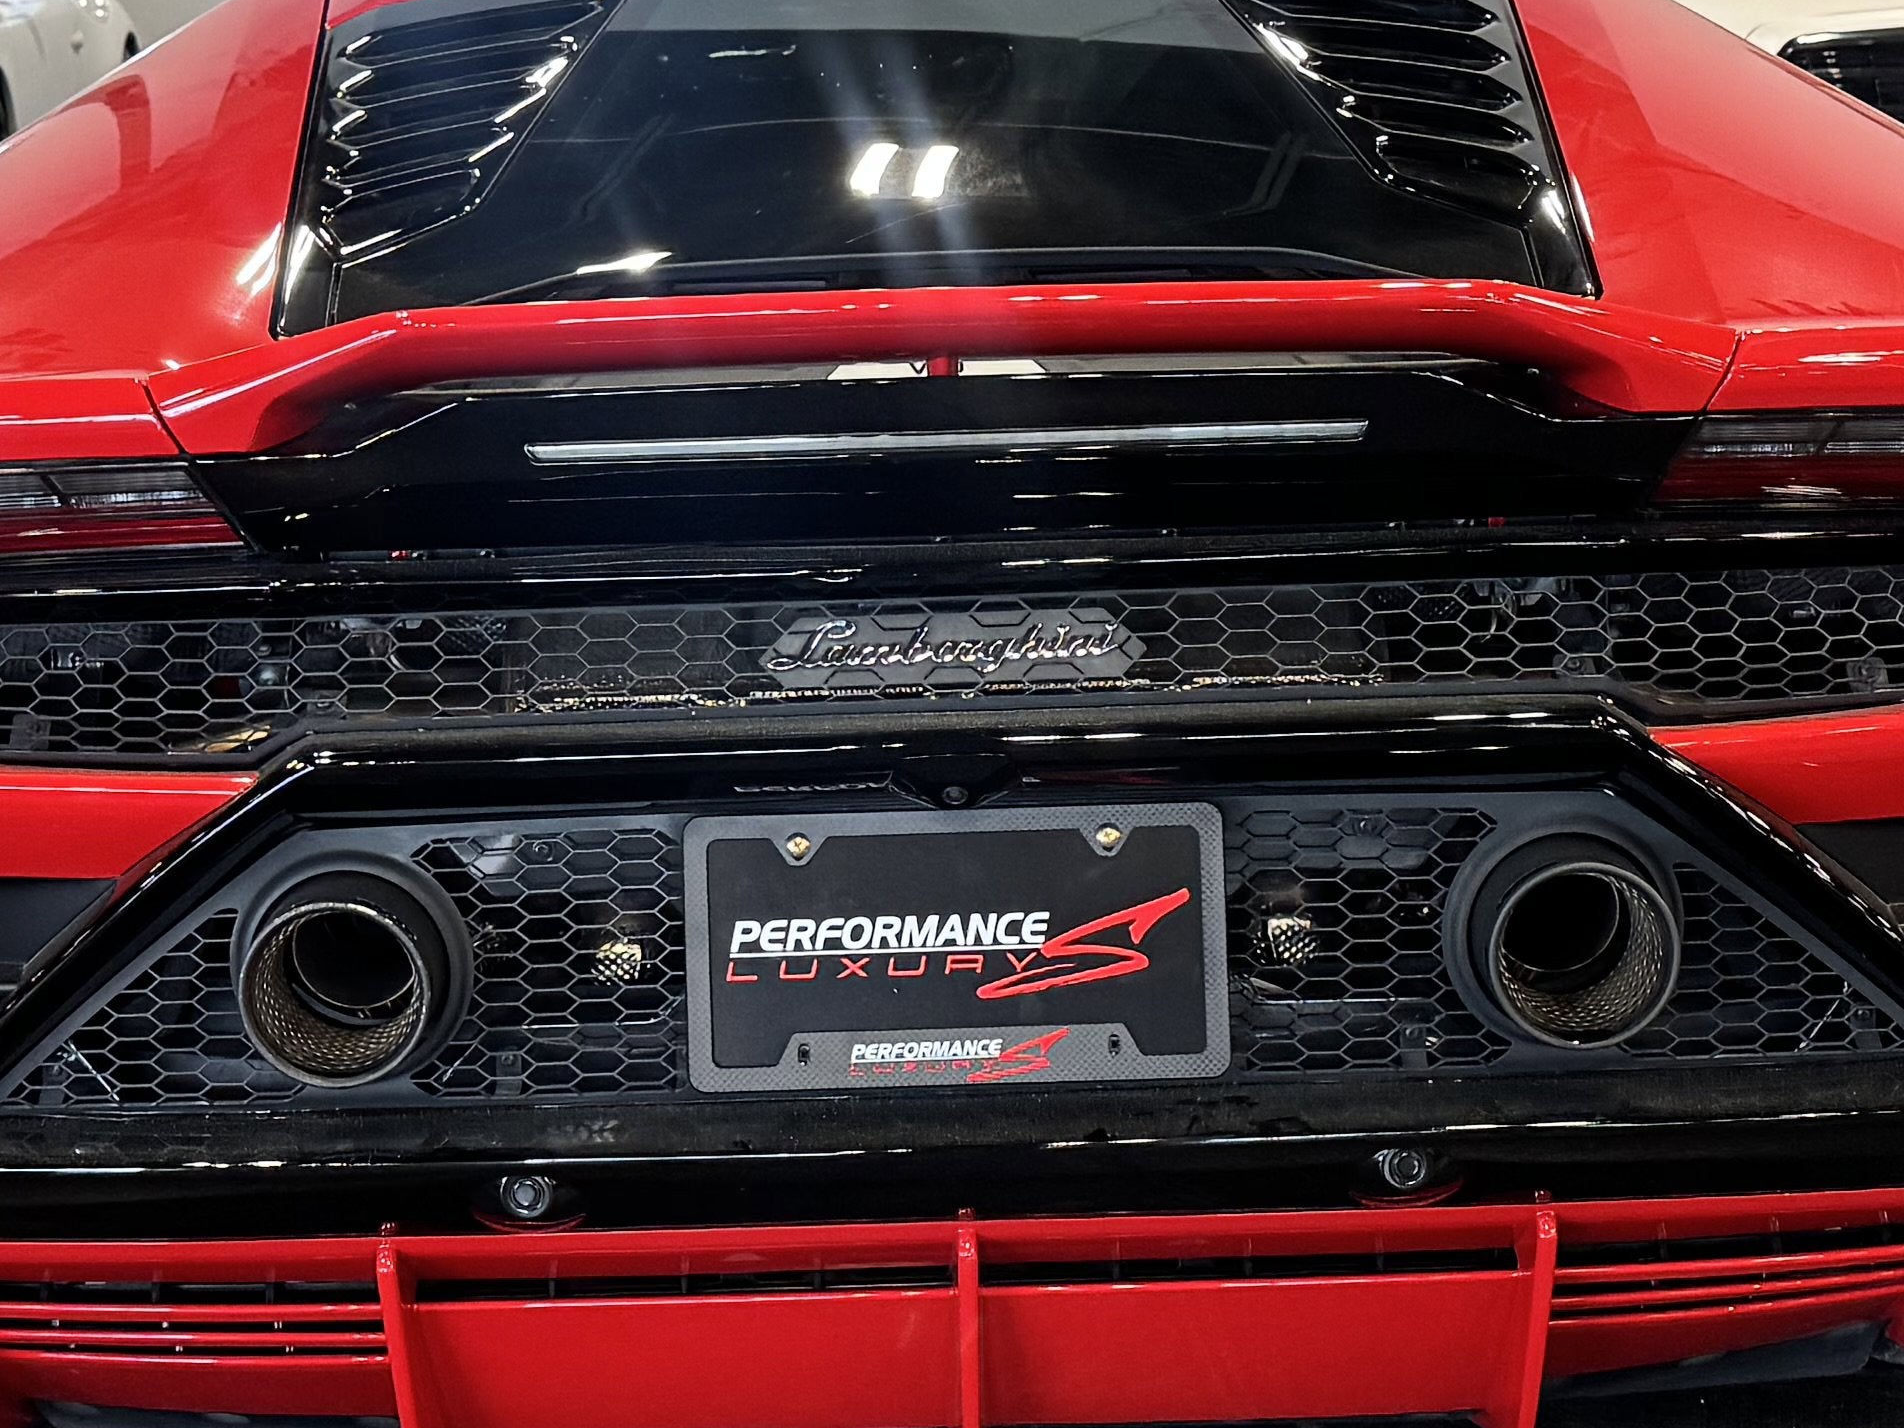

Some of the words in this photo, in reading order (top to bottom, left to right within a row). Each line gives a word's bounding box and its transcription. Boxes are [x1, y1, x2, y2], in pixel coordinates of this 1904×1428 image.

[767, 620, 1119, 672] Lamborghini
[730, 912, 1049, 950] PERFORMANCE
[726, 953, 1037, 982] LUXURY
[851, 1039, 1003, 1060] PERFORMANCE
